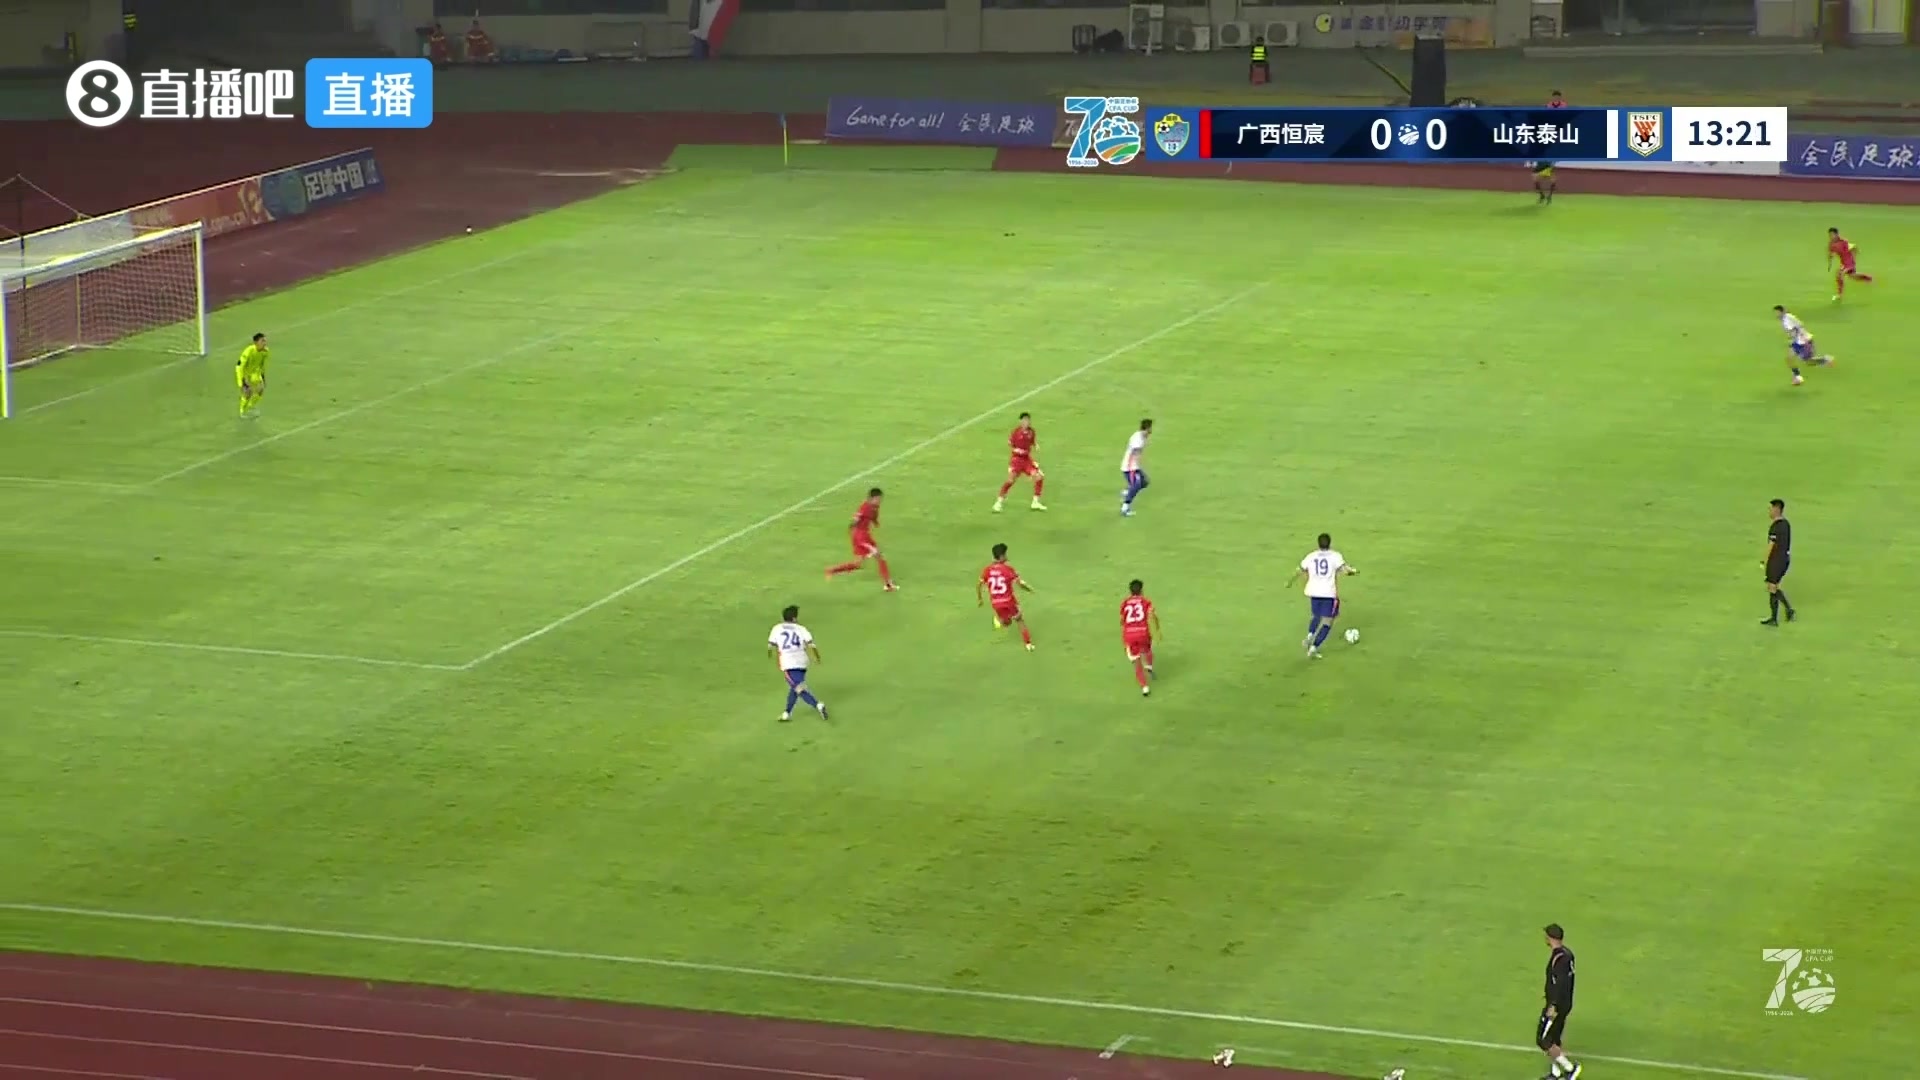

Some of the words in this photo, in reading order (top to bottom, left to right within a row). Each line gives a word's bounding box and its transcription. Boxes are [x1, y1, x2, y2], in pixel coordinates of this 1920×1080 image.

[847, 106, 887, 127] Game
[890, 113, 915, 129] for
[919, 112, 945, 129] all!
[958, 113, 1035, 134] 全民足球
[1800, 140, 1914, 169] 全民足球
[304, 161, 365, 202] 足球中国
[1314, 558, 1328, 575] 19
[988, 576, 1007, 594] 25
[1124, 604, 1145, 624] 23
[781, 631, 800, 650] 24
